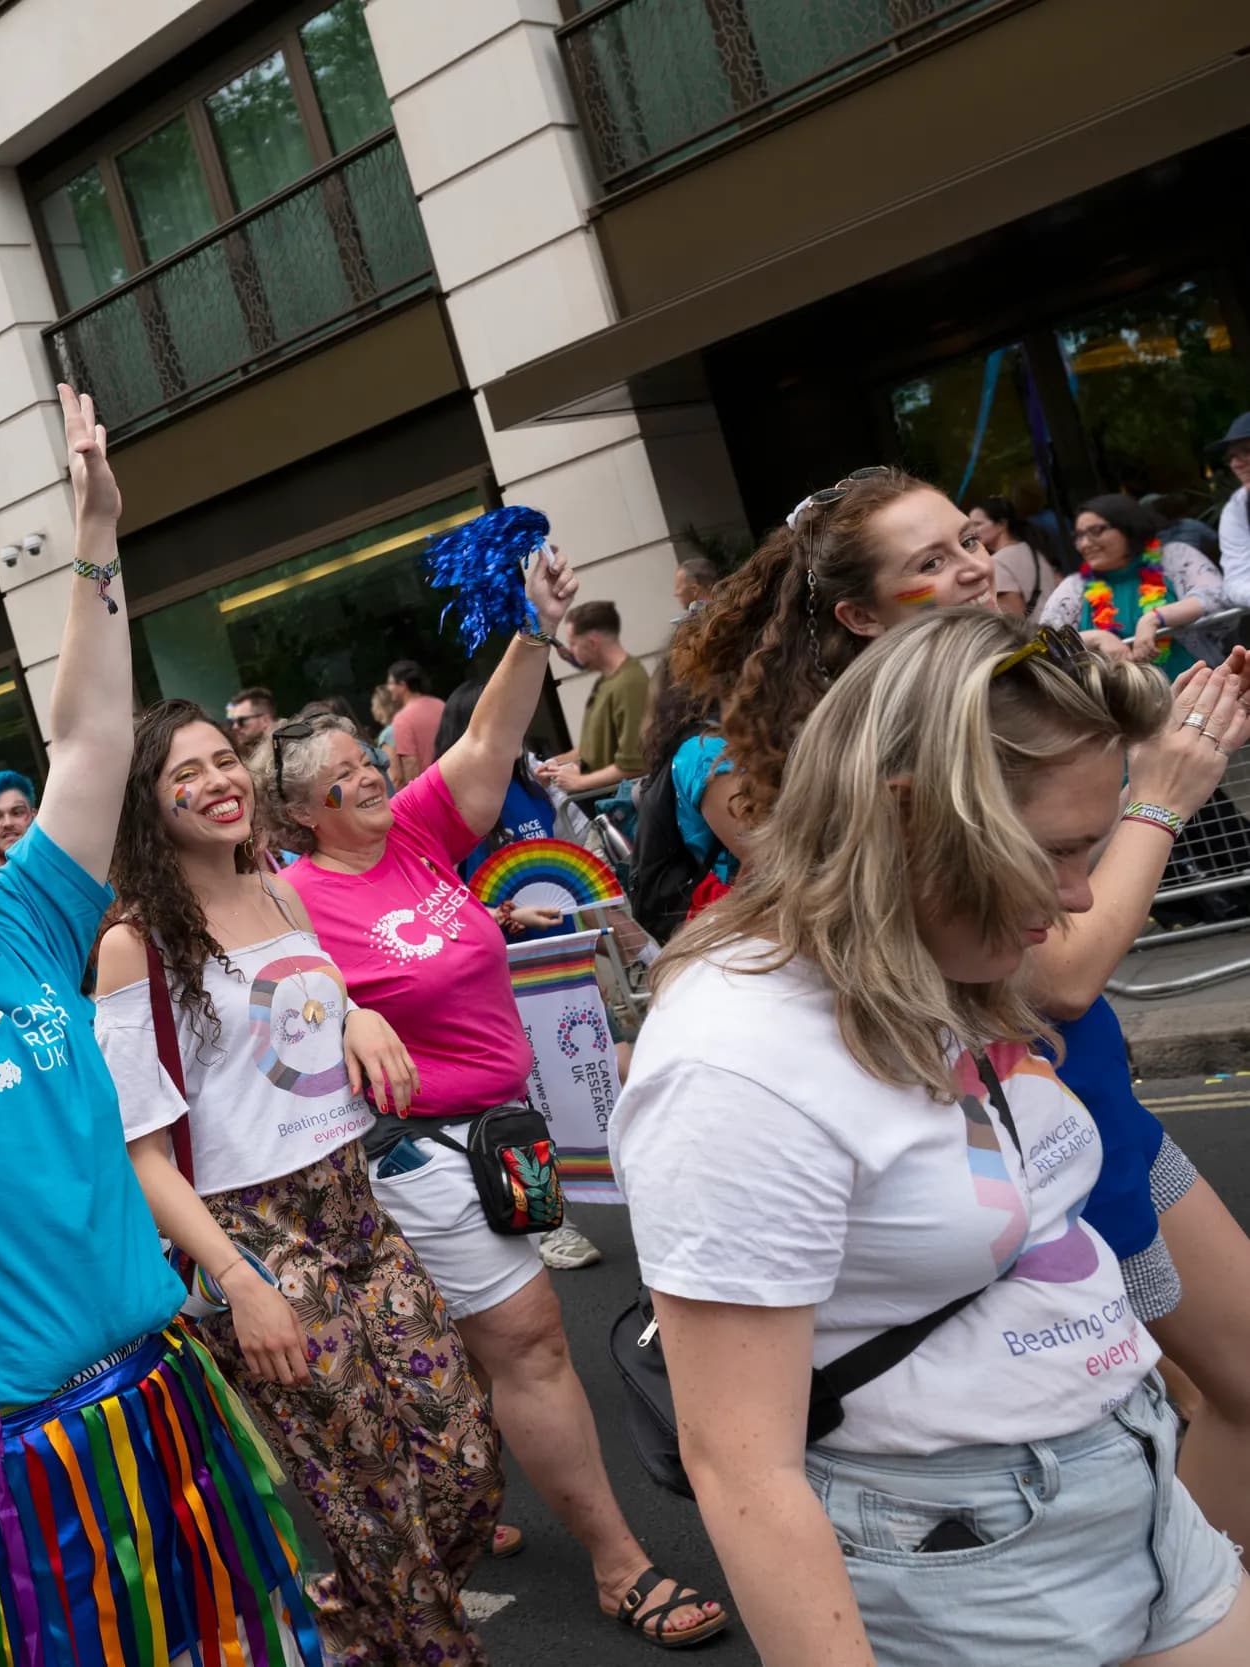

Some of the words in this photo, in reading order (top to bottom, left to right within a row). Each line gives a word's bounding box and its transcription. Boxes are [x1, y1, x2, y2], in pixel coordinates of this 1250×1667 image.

[1140, 808, 1169, 822] PRIDE
[32, 1044, 69, 1071] UK
[571, 1065, 585, 1084] UK
[536, 1083, 547, 1101] we
[585, 1062, 608, 1132] RESEARCH
[278, 1112, 329, 1137] Beating
[541, 1102, 553, 1122] are
[1033, 1126, 1097, 1173] RESEARCH
[1002, 1314, 1105, 1356] Beating
